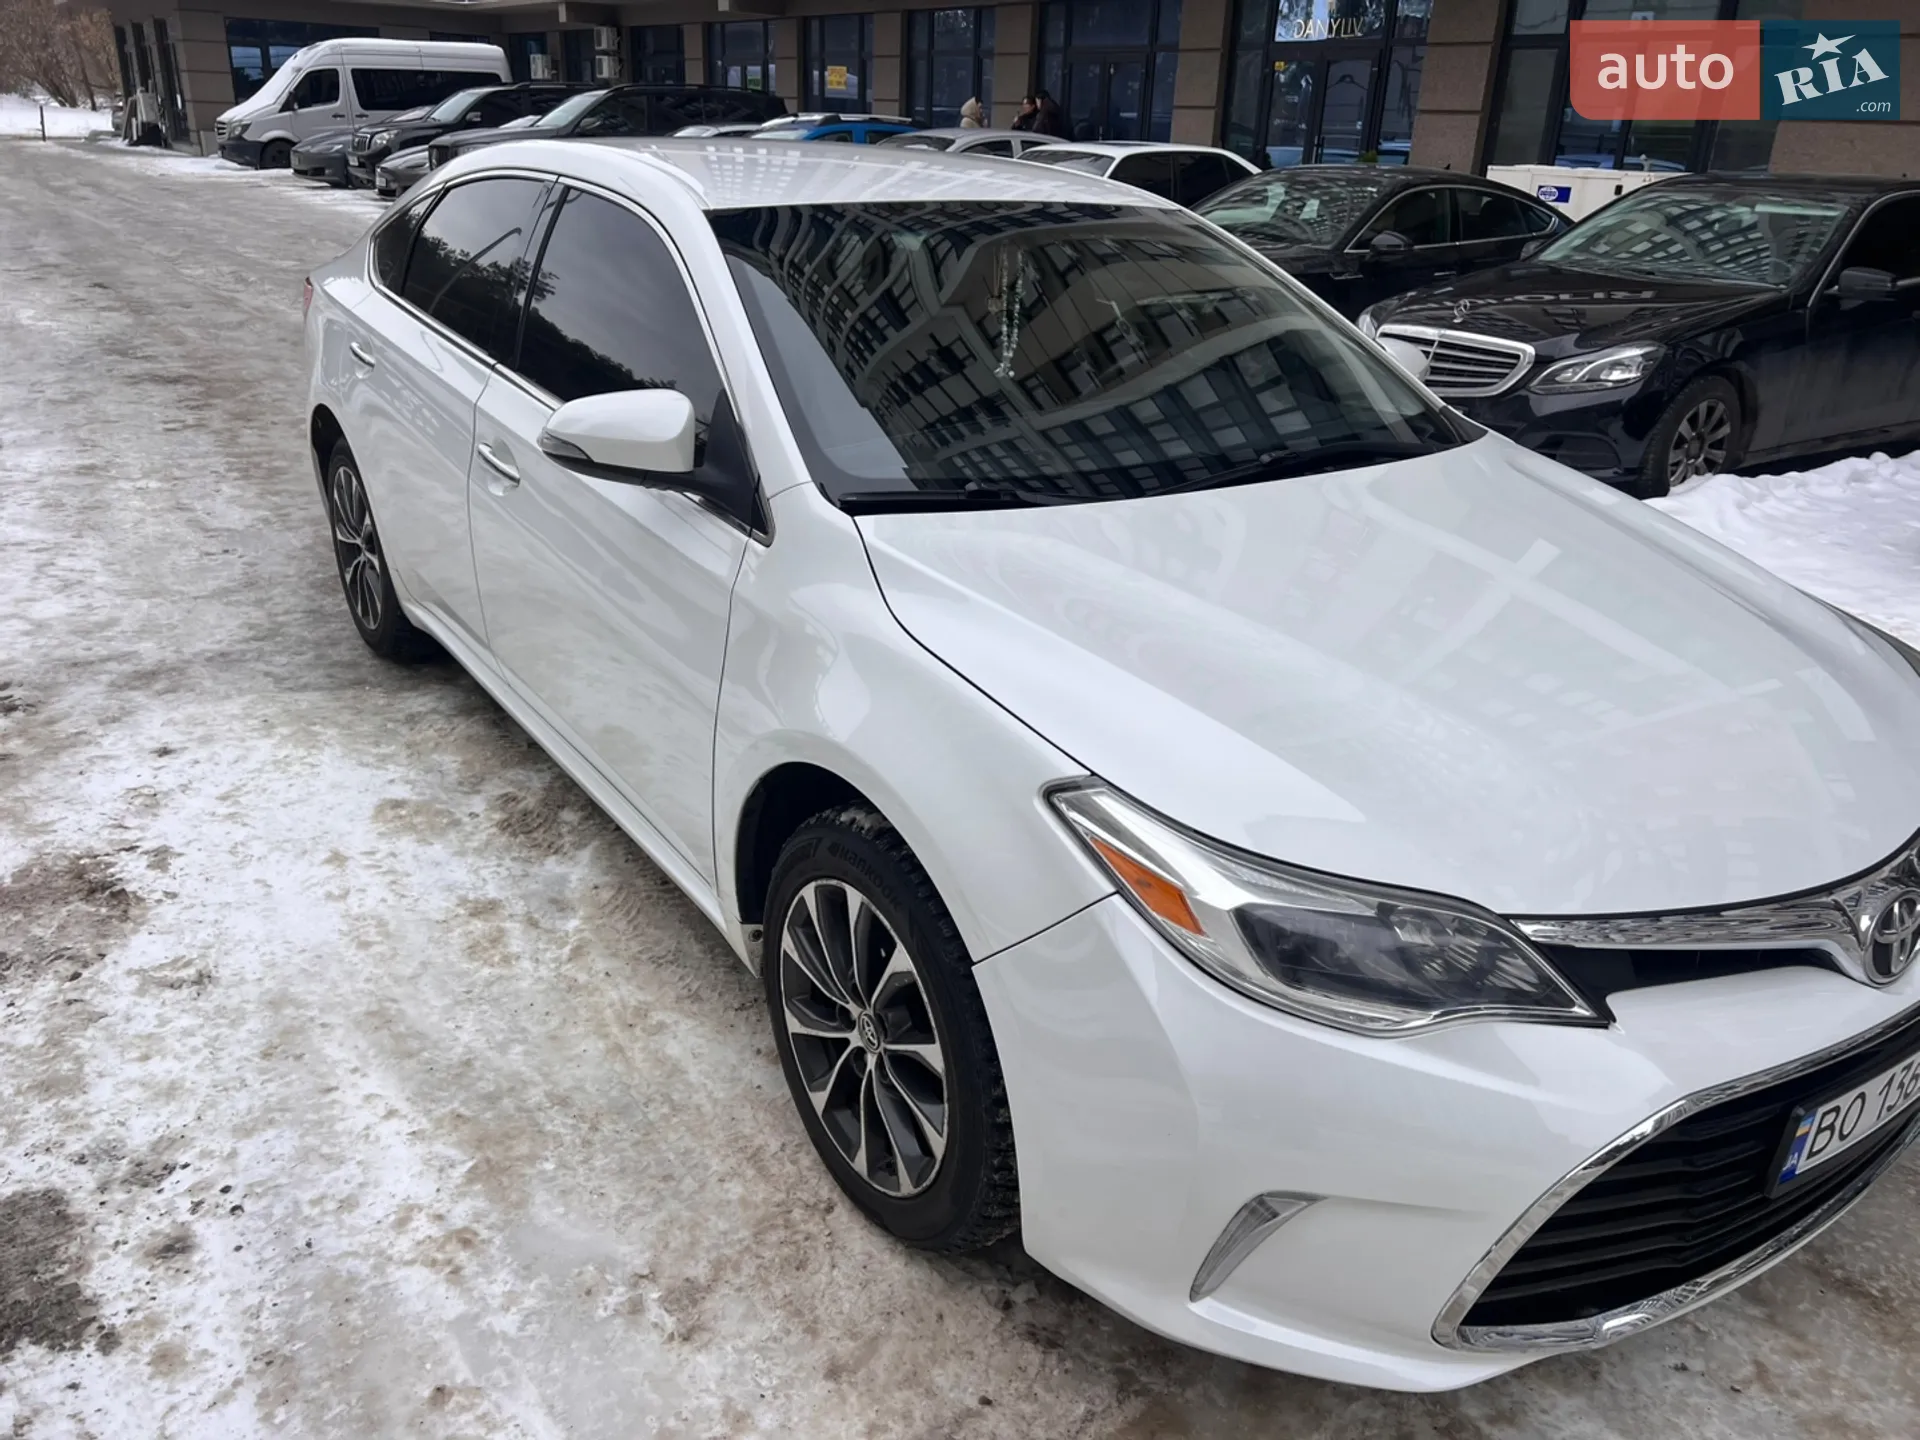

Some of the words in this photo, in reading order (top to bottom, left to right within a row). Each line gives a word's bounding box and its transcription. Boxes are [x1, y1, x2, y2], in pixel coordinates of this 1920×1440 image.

[1293, 17, 1363, 39] DANYLIV
[1805, 1091, 1867, 1161] BO
[1876, 1060, 1920, 1121] 136
